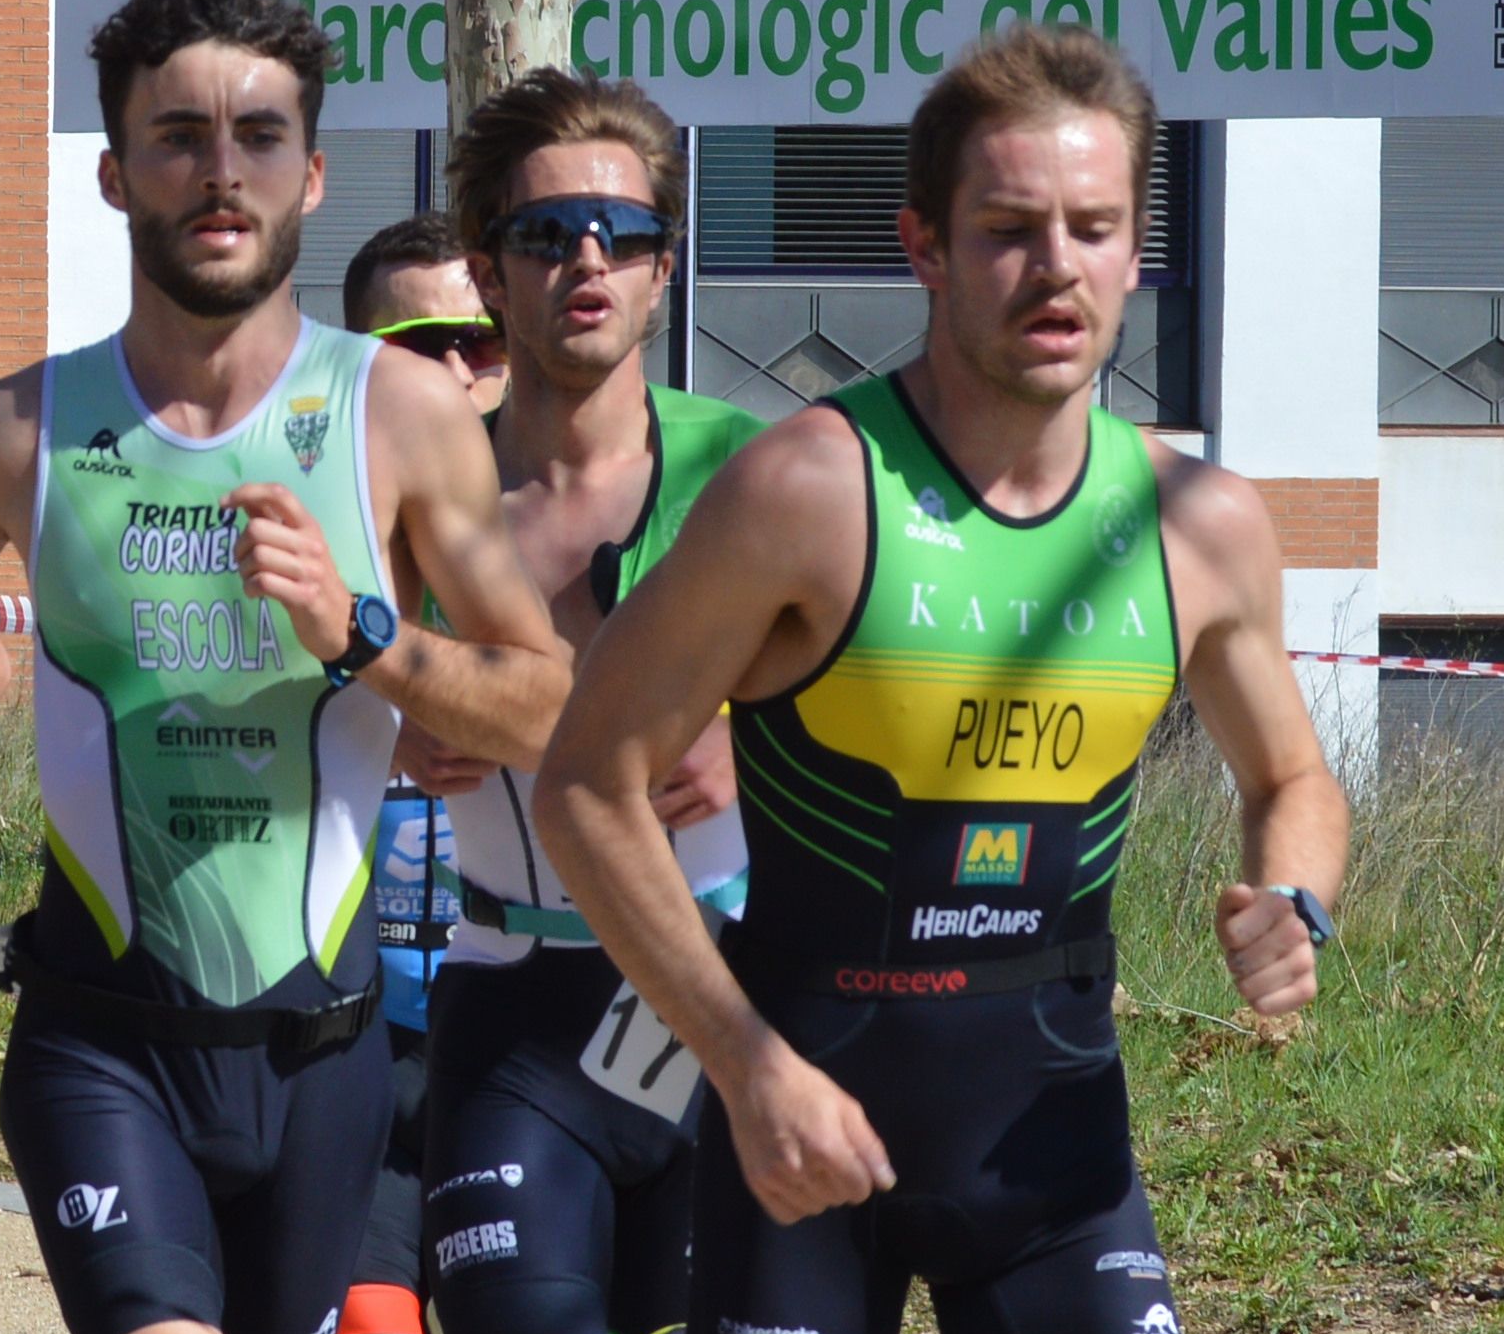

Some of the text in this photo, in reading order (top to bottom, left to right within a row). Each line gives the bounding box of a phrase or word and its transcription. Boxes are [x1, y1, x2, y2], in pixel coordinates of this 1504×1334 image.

[73, 459, 136, 479] austral
[119, 524, 242, 576] CORNEL
[904, 522, 965, 552] austral
[908, 582, 1148, 638] KATOA
[131, 597, 284, 672] ESCOLA
[156, 725, 277, 748] ENINTER
[945, 698, 1084, 771] PUEYO
[168, 795, 272, 811] RESTAURANTE
[168, 812, 272, 844] ORTIZ
[435, 1219, 518, 1272] 226ERS
